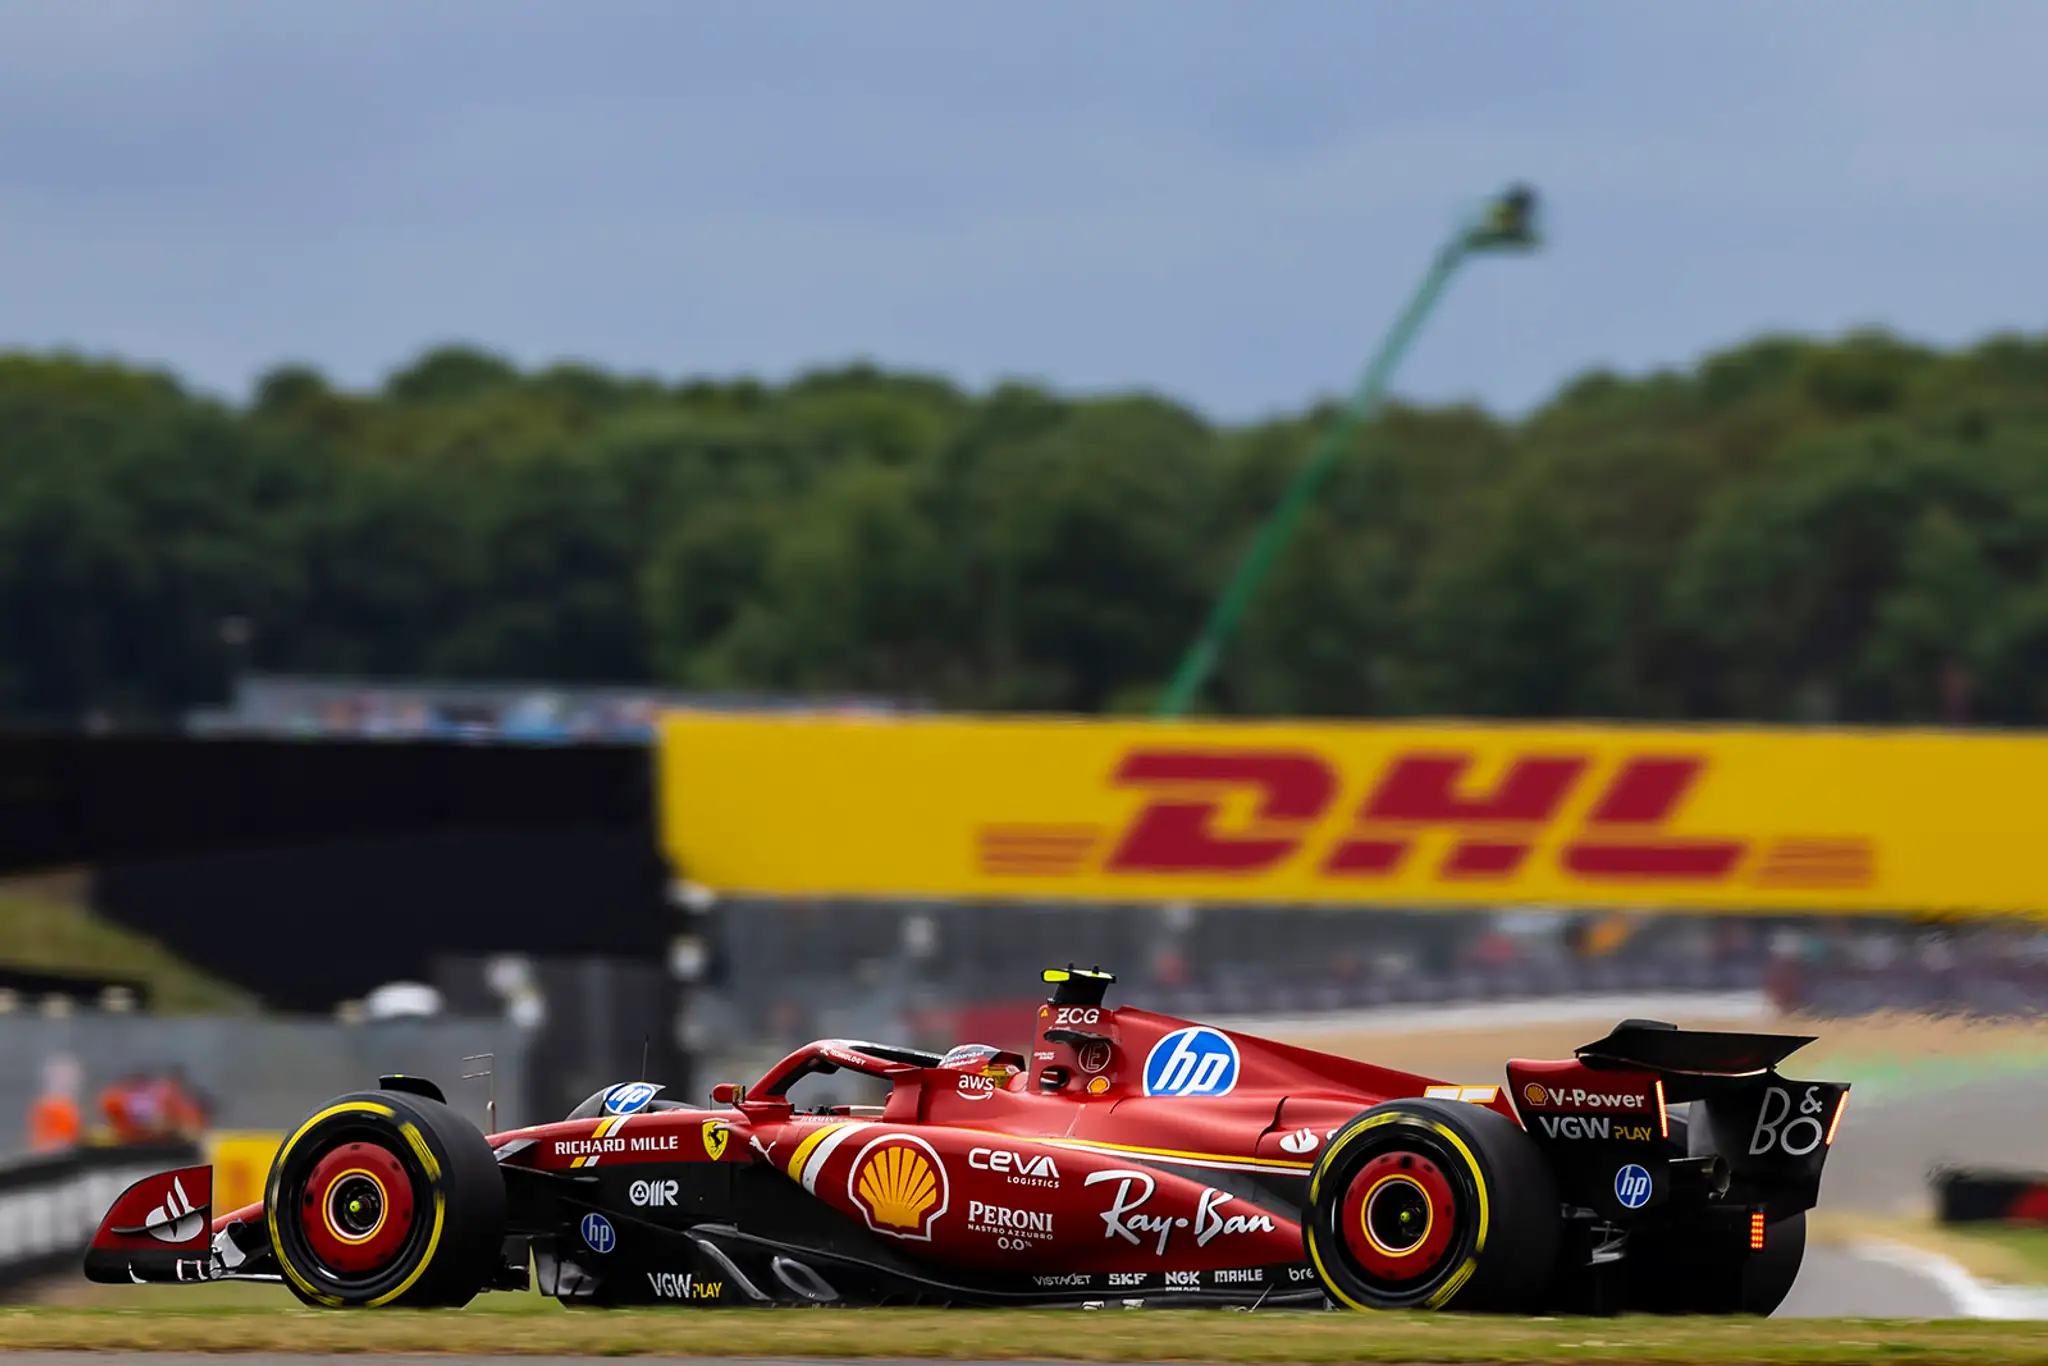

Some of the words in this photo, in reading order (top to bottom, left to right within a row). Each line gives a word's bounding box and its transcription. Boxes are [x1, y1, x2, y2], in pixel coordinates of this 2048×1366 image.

[1101, 749, 1753, 880] DHL
[1055, 1007, 1100, 1024] ZCG
[1149, 1027, 1234, 1096] hp
[958, 1074, 995, 1091] aws
[606, 1083, 653, 1113] hp
[1548, 1088, 1645, 1108] V-Power
[1538, 1116, 1610, 1139] VGW
[1612, 1126, 1652, 1142] PLAY
[555, 1139, 625, 1155] RICHARD
[631, 1136, 679, 1151] MILLE
[1007, 1176, 1060, 1189] LOGISTICS
[1617, 1165, 1650, 1208] hp
[968, 1200, 1054, 1233] PERONI
[586, 1213, 612, 1253] hp
[967, 1223, 1005, 1235] NASTRO
[1007, 1230, 1054, 1241] AZZURRO
[647, 1273, 692, 1298] VGW
[692, 1282, 723, 1299] PLAY
[1108, 1273, 1148, 1285] SKF
[1165, 1270, 1200, 1285] NGK
[1214, 1269, 1264, 1283] MAHLE
